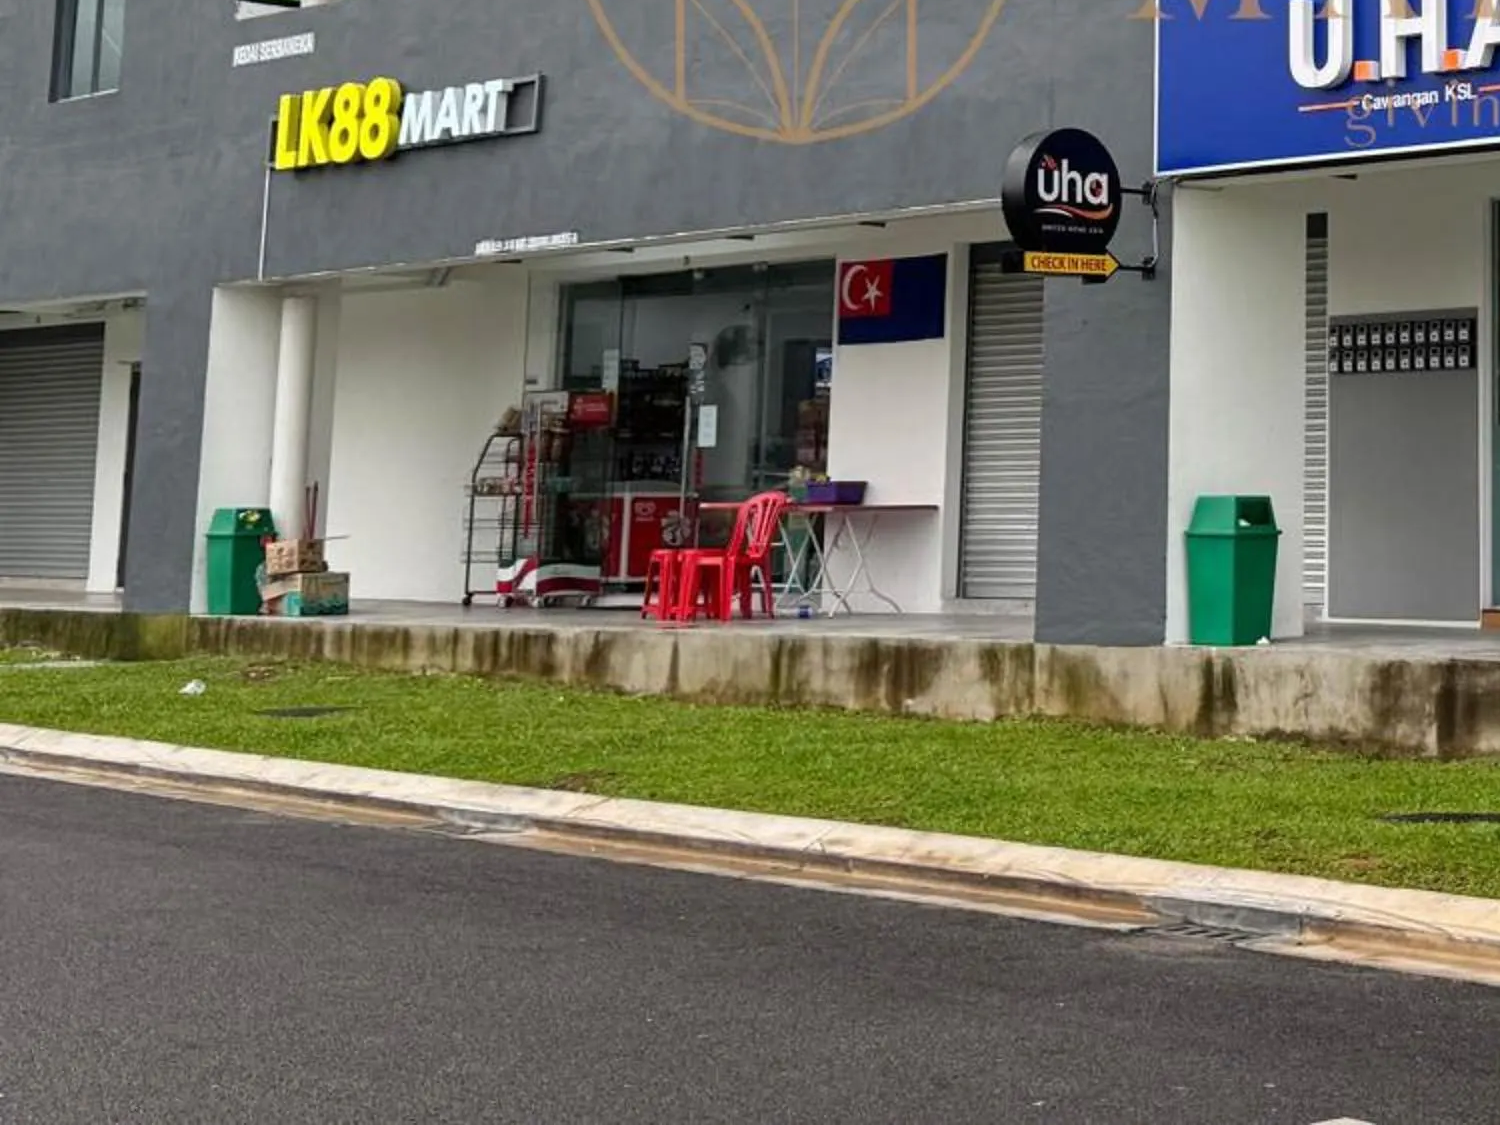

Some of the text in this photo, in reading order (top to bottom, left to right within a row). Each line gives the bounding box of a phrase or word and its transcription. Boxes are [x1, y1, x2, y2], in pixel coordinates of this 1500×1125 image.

[1361, 82, 1478, 111] Cawangan KSL
[275, 76, 513, 170] LK88 MART
[1031, 255, 1107, 272] CHECK IN HERE
